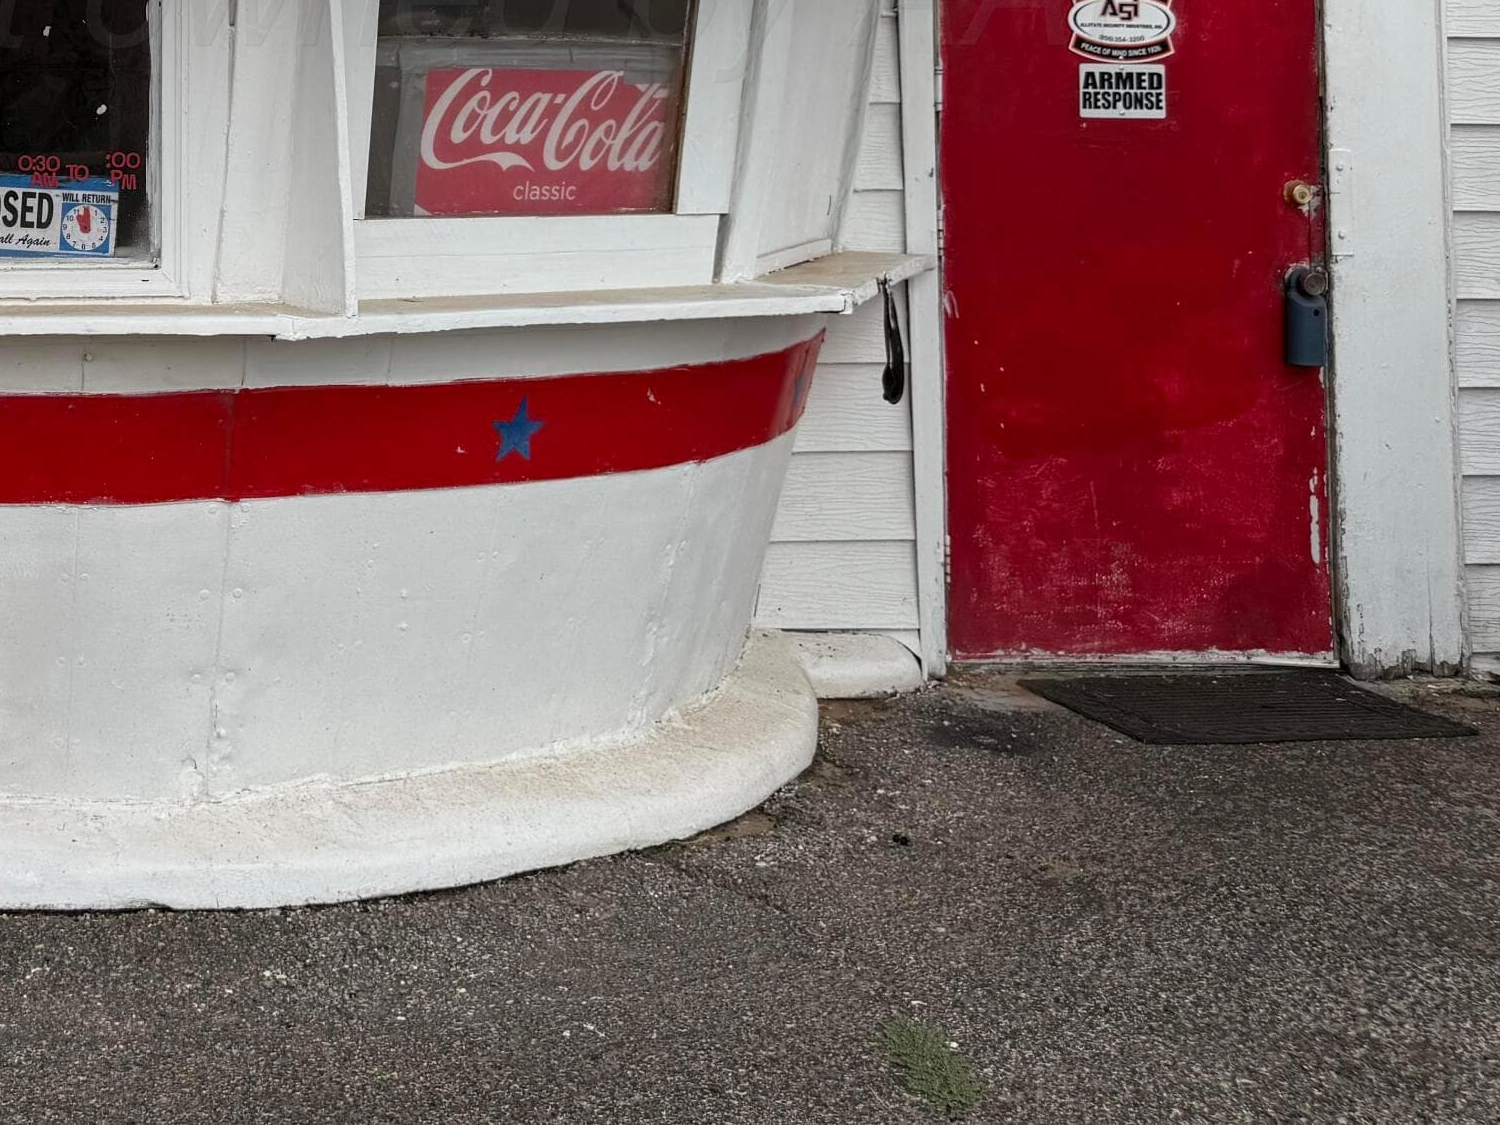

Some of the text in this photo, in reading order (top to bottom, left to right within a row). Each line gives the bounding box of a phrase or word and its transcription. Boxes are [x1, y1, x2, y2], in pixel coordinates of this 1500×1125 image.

[1082, 71, 1163, 91] ARMED
[1082, 91, 1163, 111] RESPONSE
[419, 68, 669, 173] Coca-Cola
[29, 171, 60, 188] AM
[66, 164, 90, 181] TO
[110, 169, 137, 190] PM
[62, 192, 111, 204] WILL RETURN
[513, 180, 577, 202] classic
[14, 234, 51, 249] Again
